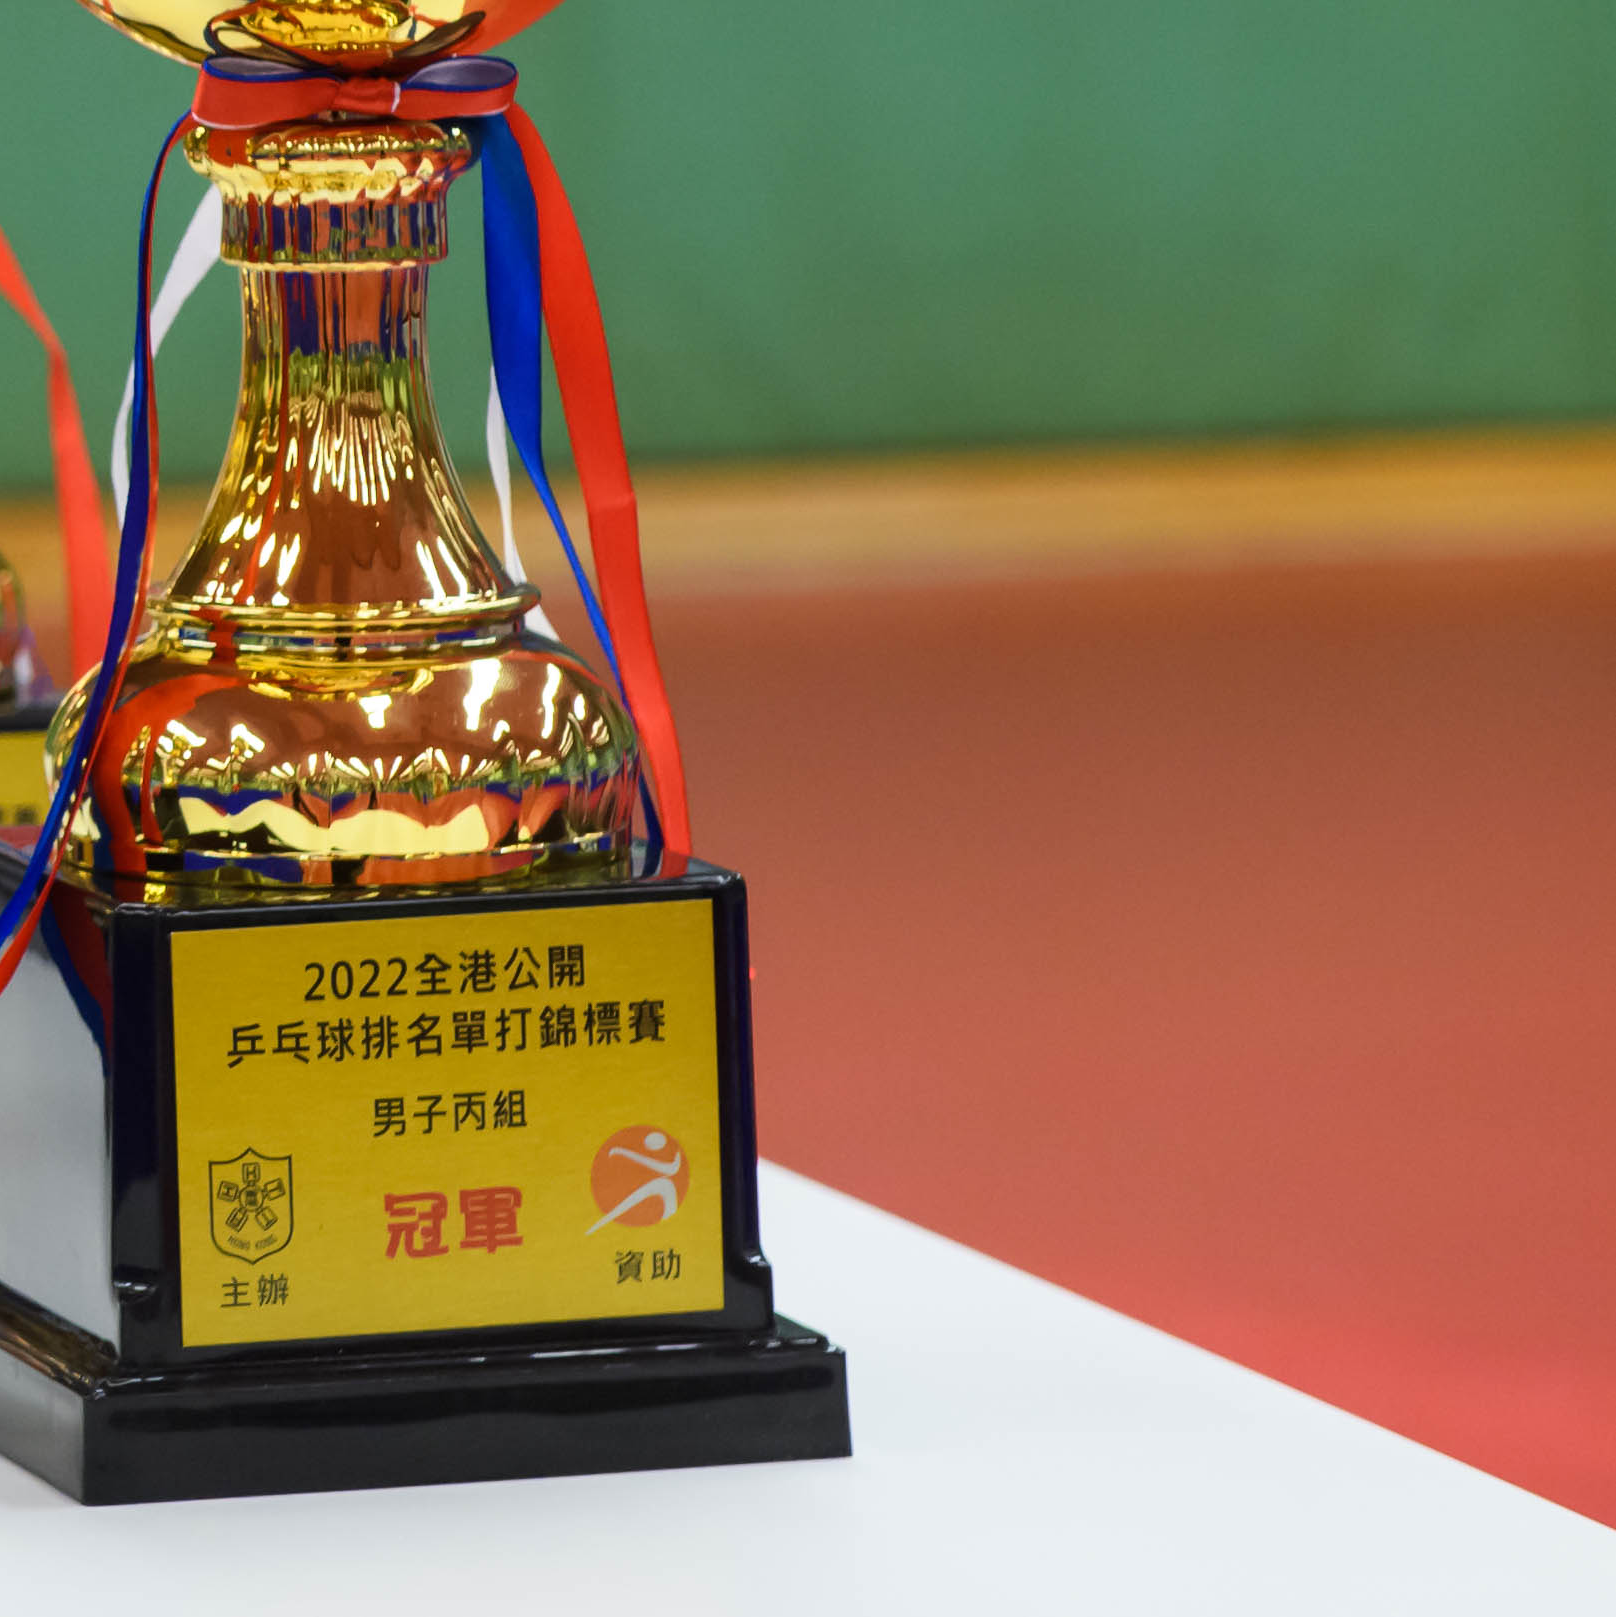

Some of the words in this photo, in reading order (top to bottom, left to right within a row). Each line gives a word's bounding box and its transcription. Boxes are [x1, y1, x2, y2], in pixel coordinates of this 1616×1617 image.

[304, 944, 586, 1002] 2022全港公開
[226, 996, 666, 1070] 乒乓球排名單打錦標賽
[373, 1089, 528, 1139] 男子丙組
[382, 1185, 524, 1260] 冠軍
[220, 1272, 289, 1308] 主辦
[614, 1248, 681, 1285] 資助
